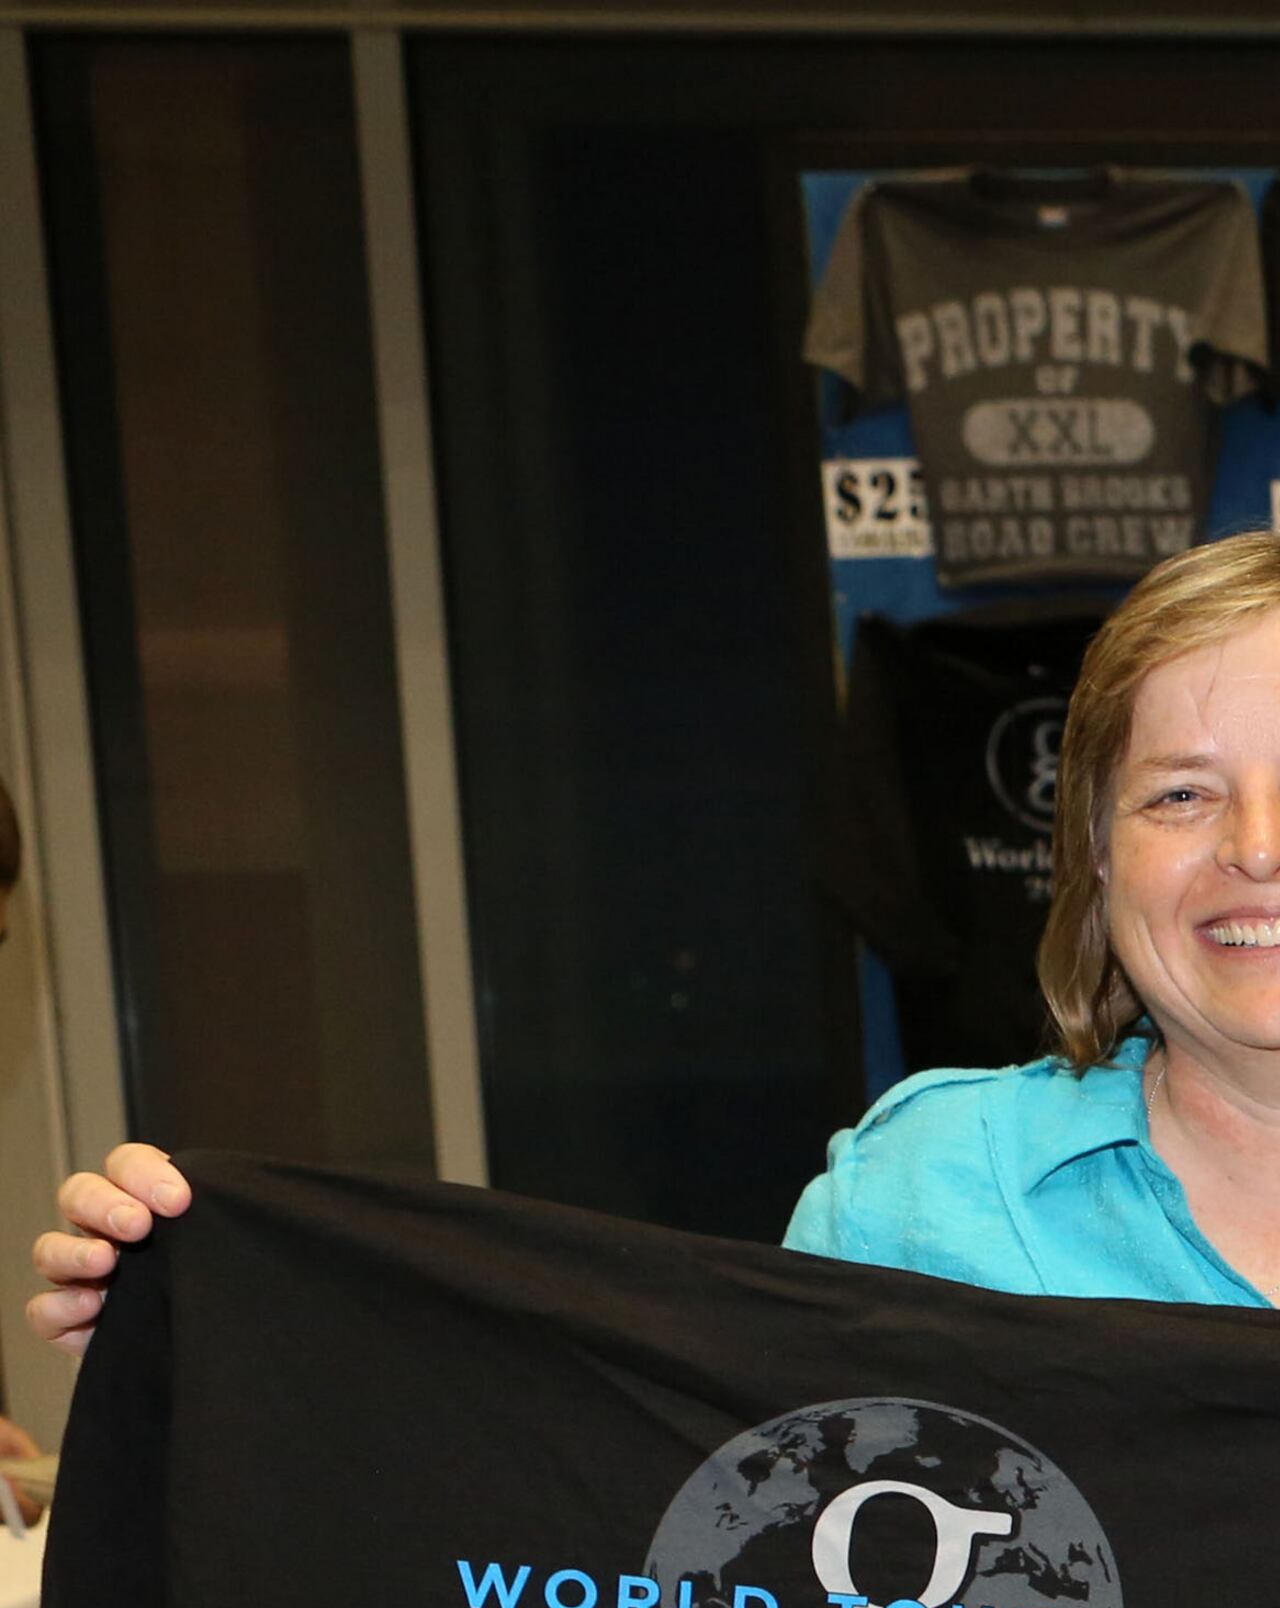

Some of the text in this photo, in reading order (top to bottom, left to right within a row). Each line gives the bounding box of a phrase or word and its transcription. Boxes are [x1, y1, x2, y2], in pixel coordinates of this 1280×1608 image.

[896, 286, 1199, 392] PROPERTY
[1008, 406, 1112, 457] XXL
[1066, 515, 1194, 557] CREW
